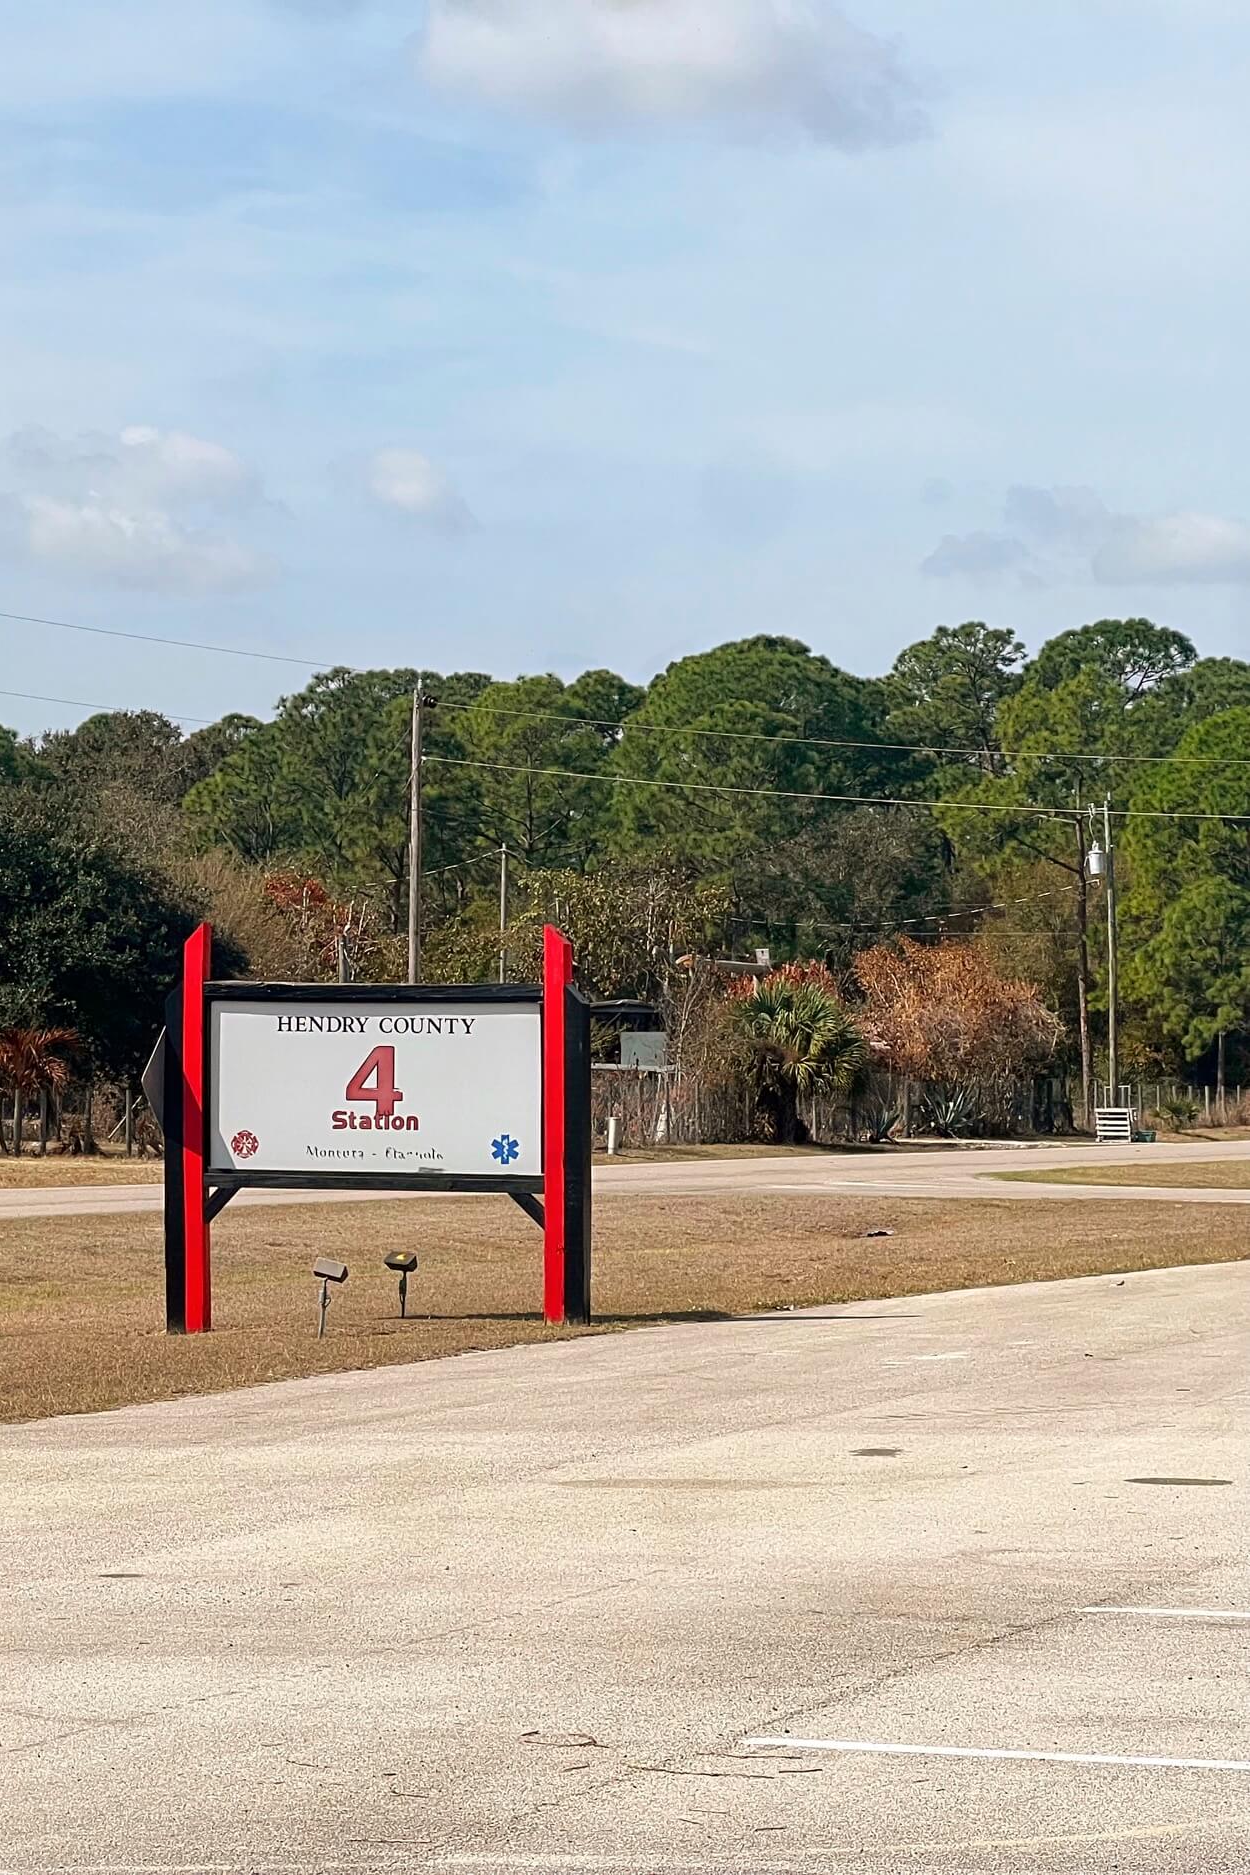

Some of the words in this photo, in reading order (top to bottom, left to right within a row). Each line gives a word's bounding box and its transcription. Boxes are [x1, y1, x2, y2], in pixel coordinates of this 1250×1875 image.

[277, 1016, 370, 1033] HENDRY
[379, 1017, 476, 1035] COUNTY
[345, 1045, 404, 1117] 4
[331, 1110, 420, 1131] Station
